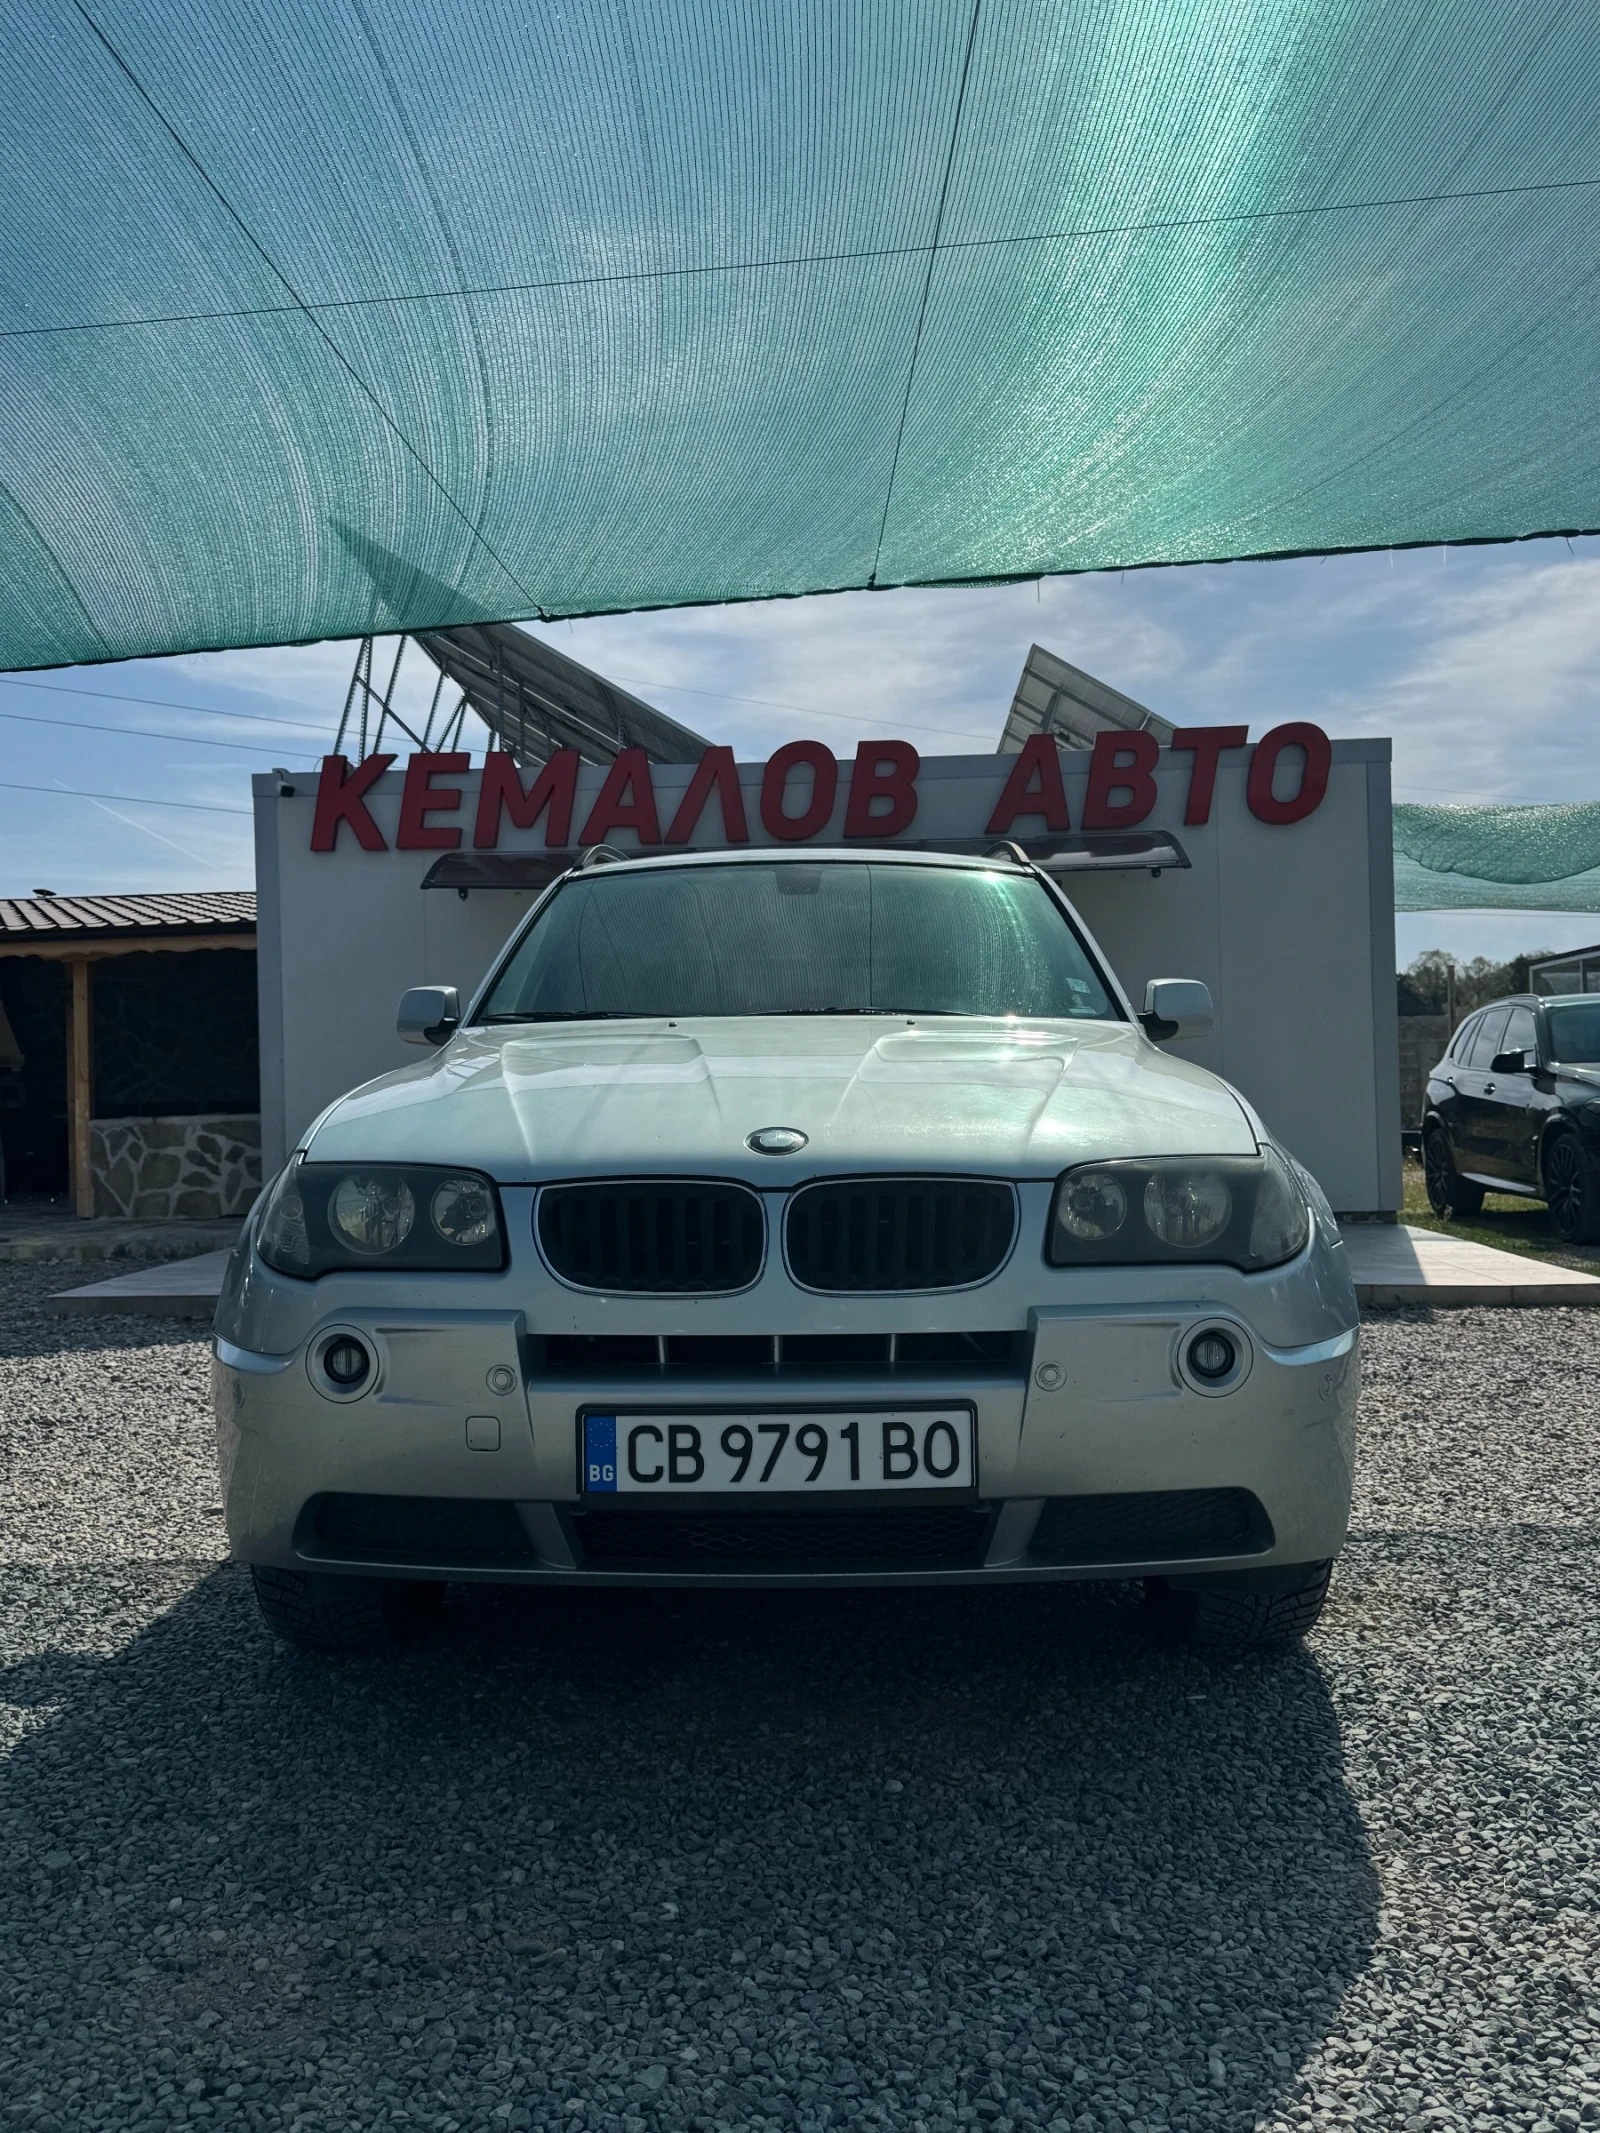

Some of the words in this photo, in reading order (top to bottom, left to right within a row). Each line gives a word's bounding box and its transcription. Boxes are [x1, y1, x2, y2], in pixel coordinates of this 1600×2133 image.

[310, 739, 920, 852] КЕМАЛОВ
[985, 721, 1332, 835] АВТО
[589, 1464, 615, 1482] BG
[627, 1424, 705, 1483] CB
[720, 1421, 861, 1483] 9791
